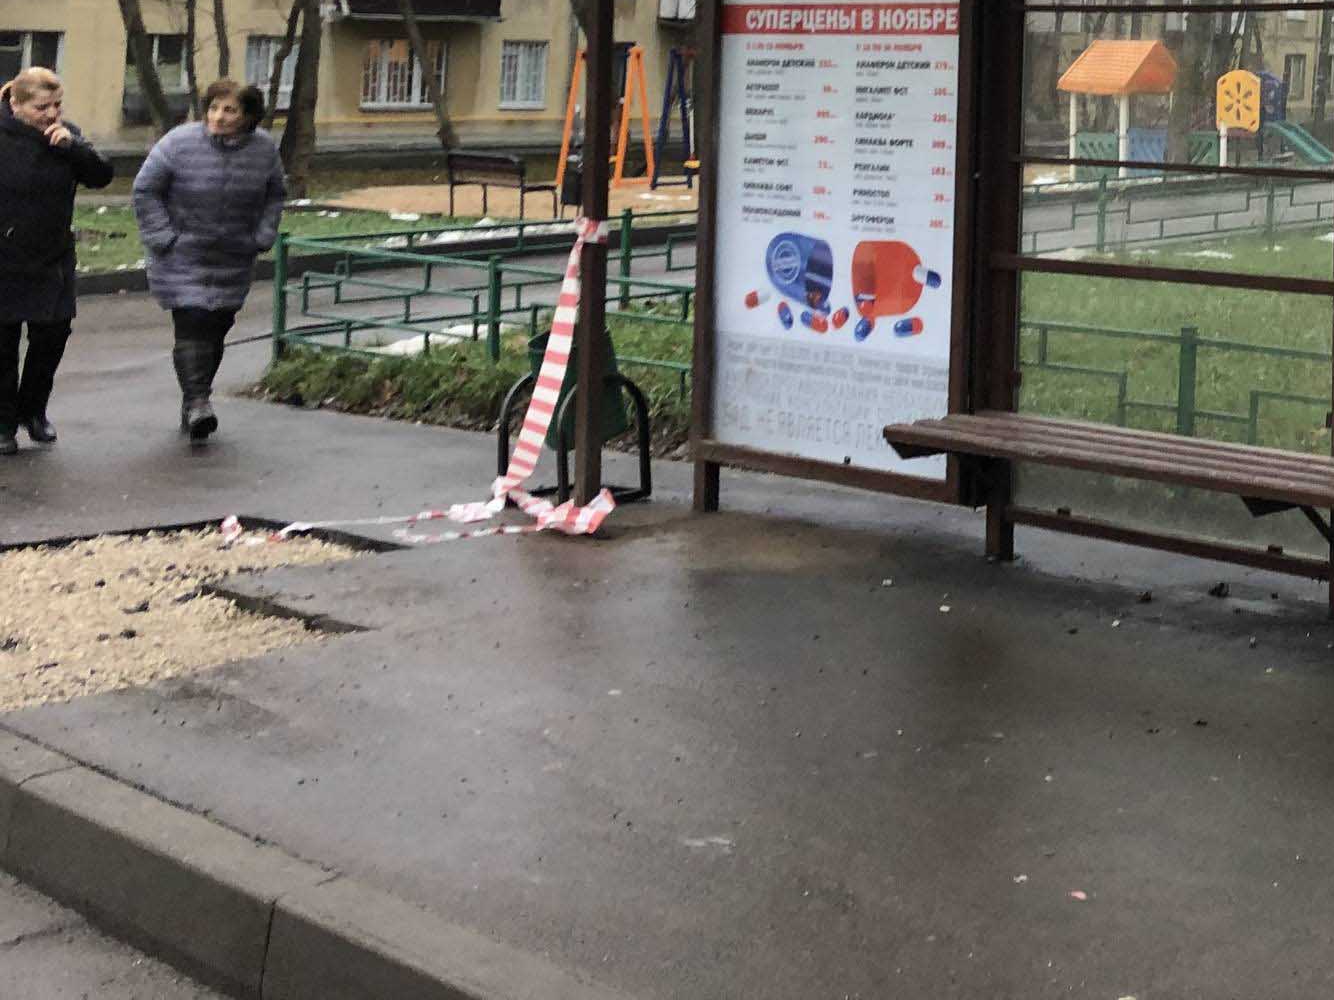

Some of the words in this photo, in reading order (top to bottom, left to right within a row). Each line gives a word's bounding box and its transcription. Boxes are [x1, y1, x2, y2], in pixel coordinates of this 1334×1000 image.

[746, 8, 857, 32] СУПЕРЦЕНЫ
[862, 10, 874, 30] В
[879, 7, 959, 31] НОЯБРЕ
